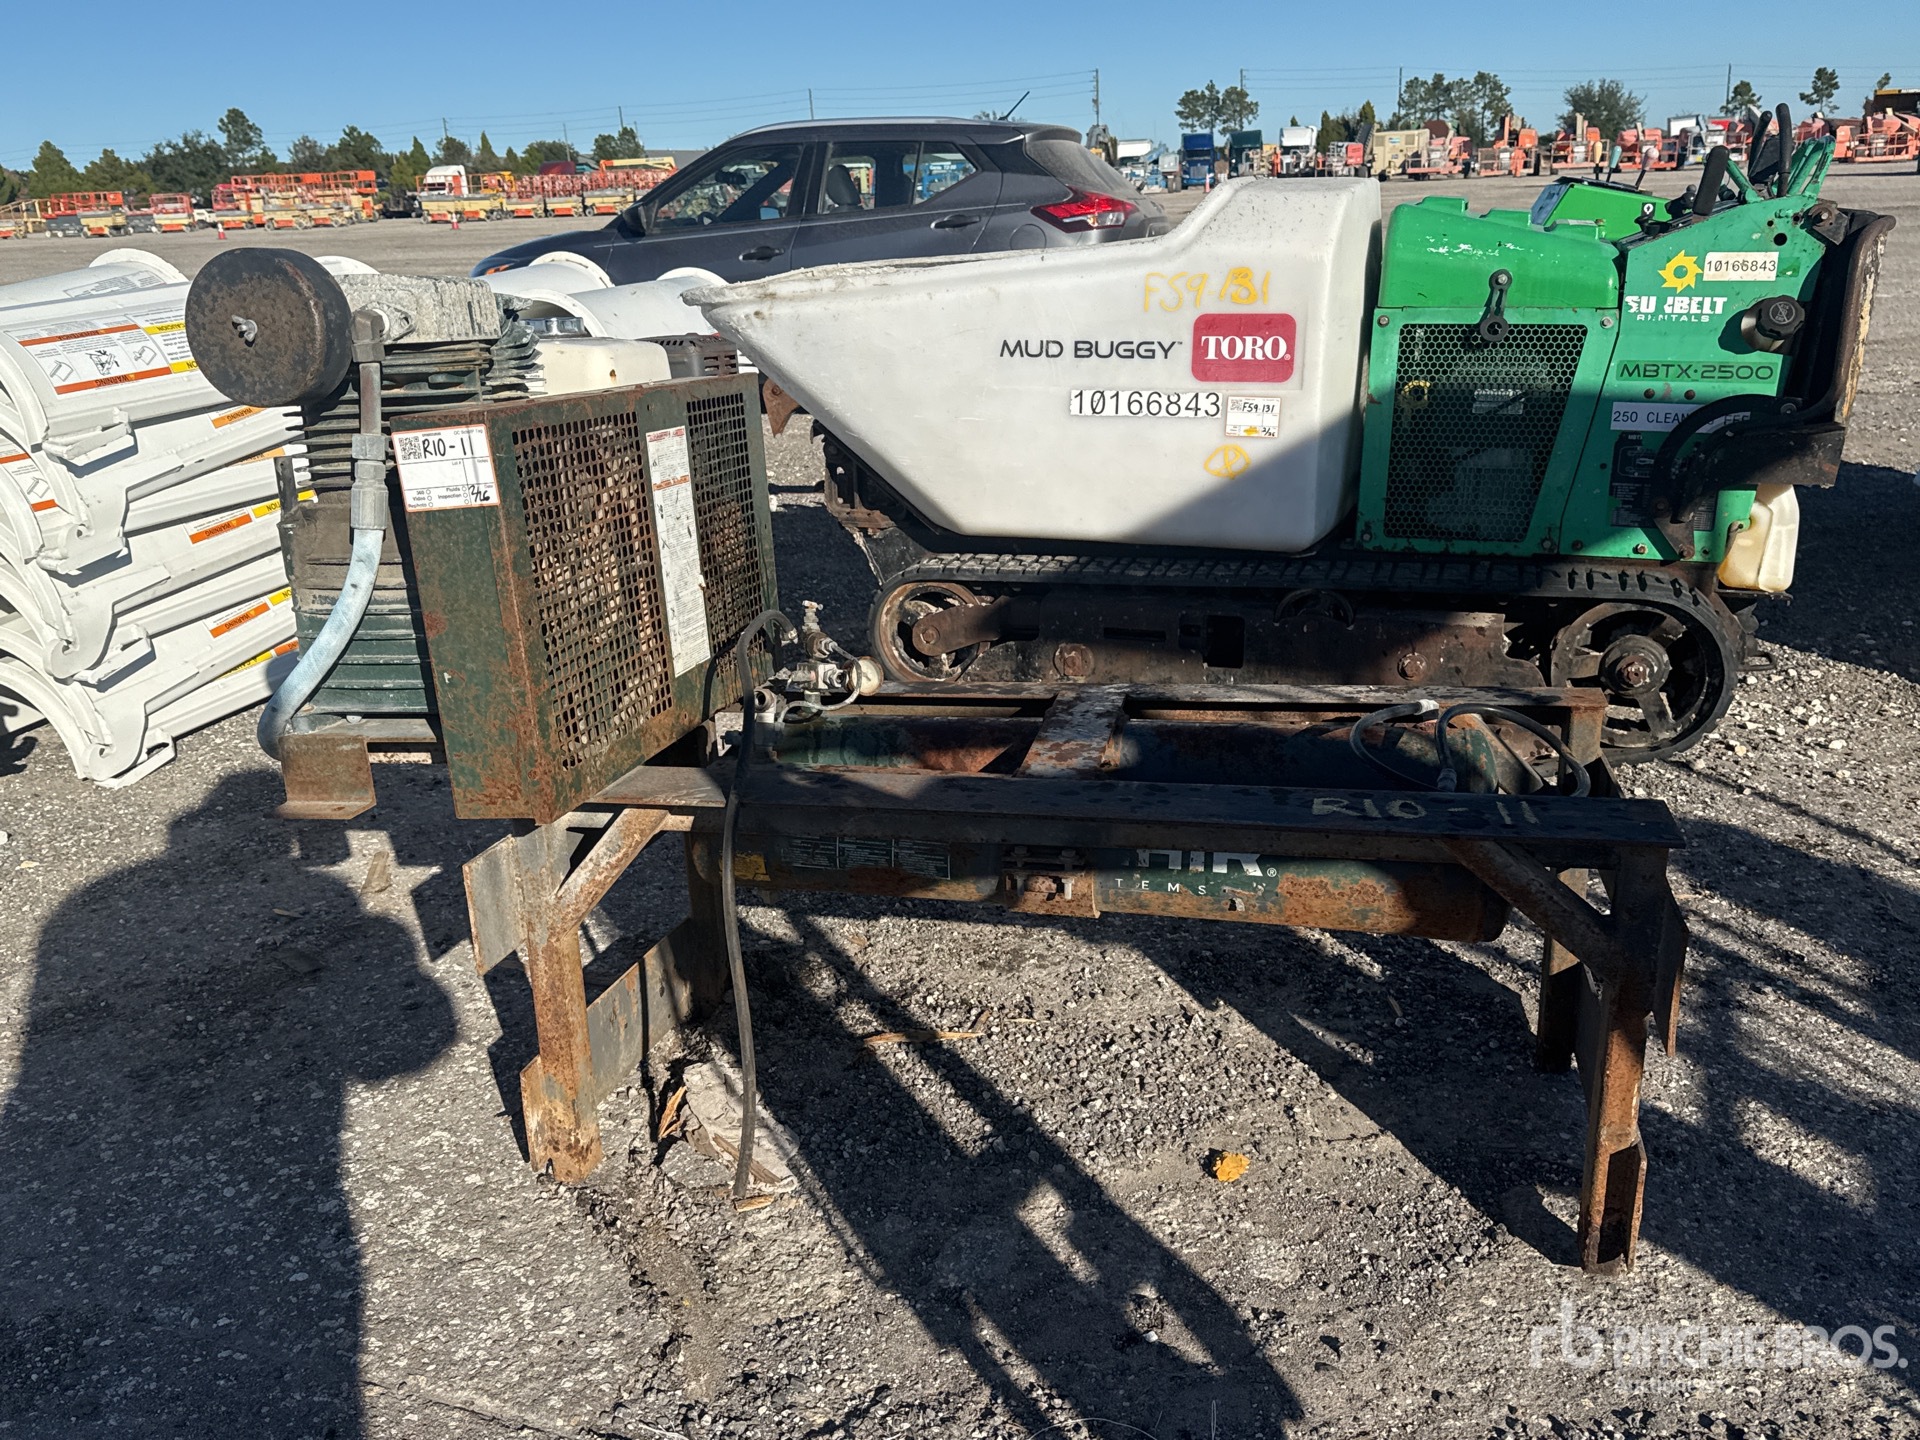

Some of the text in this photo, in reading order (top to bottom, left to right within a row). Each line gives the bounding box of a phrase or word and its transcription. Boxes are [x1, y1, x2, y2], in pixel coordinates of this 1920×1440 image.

[1706, 260, 1777, 273] 10166843
[999, 339, 1178, 360] MUD BUGGY
[1200, 335, 1288, 361] TORO
[94, 374, 129, 387] WARNING
[1073, 390, 1221, 418] 10166843
[226, 407, 253, 421] WARNING
[1613, 411, 1638, 423] 250
[204, 521, 232, 537] WARNING
[224, 613, 250, 630] WARNING
